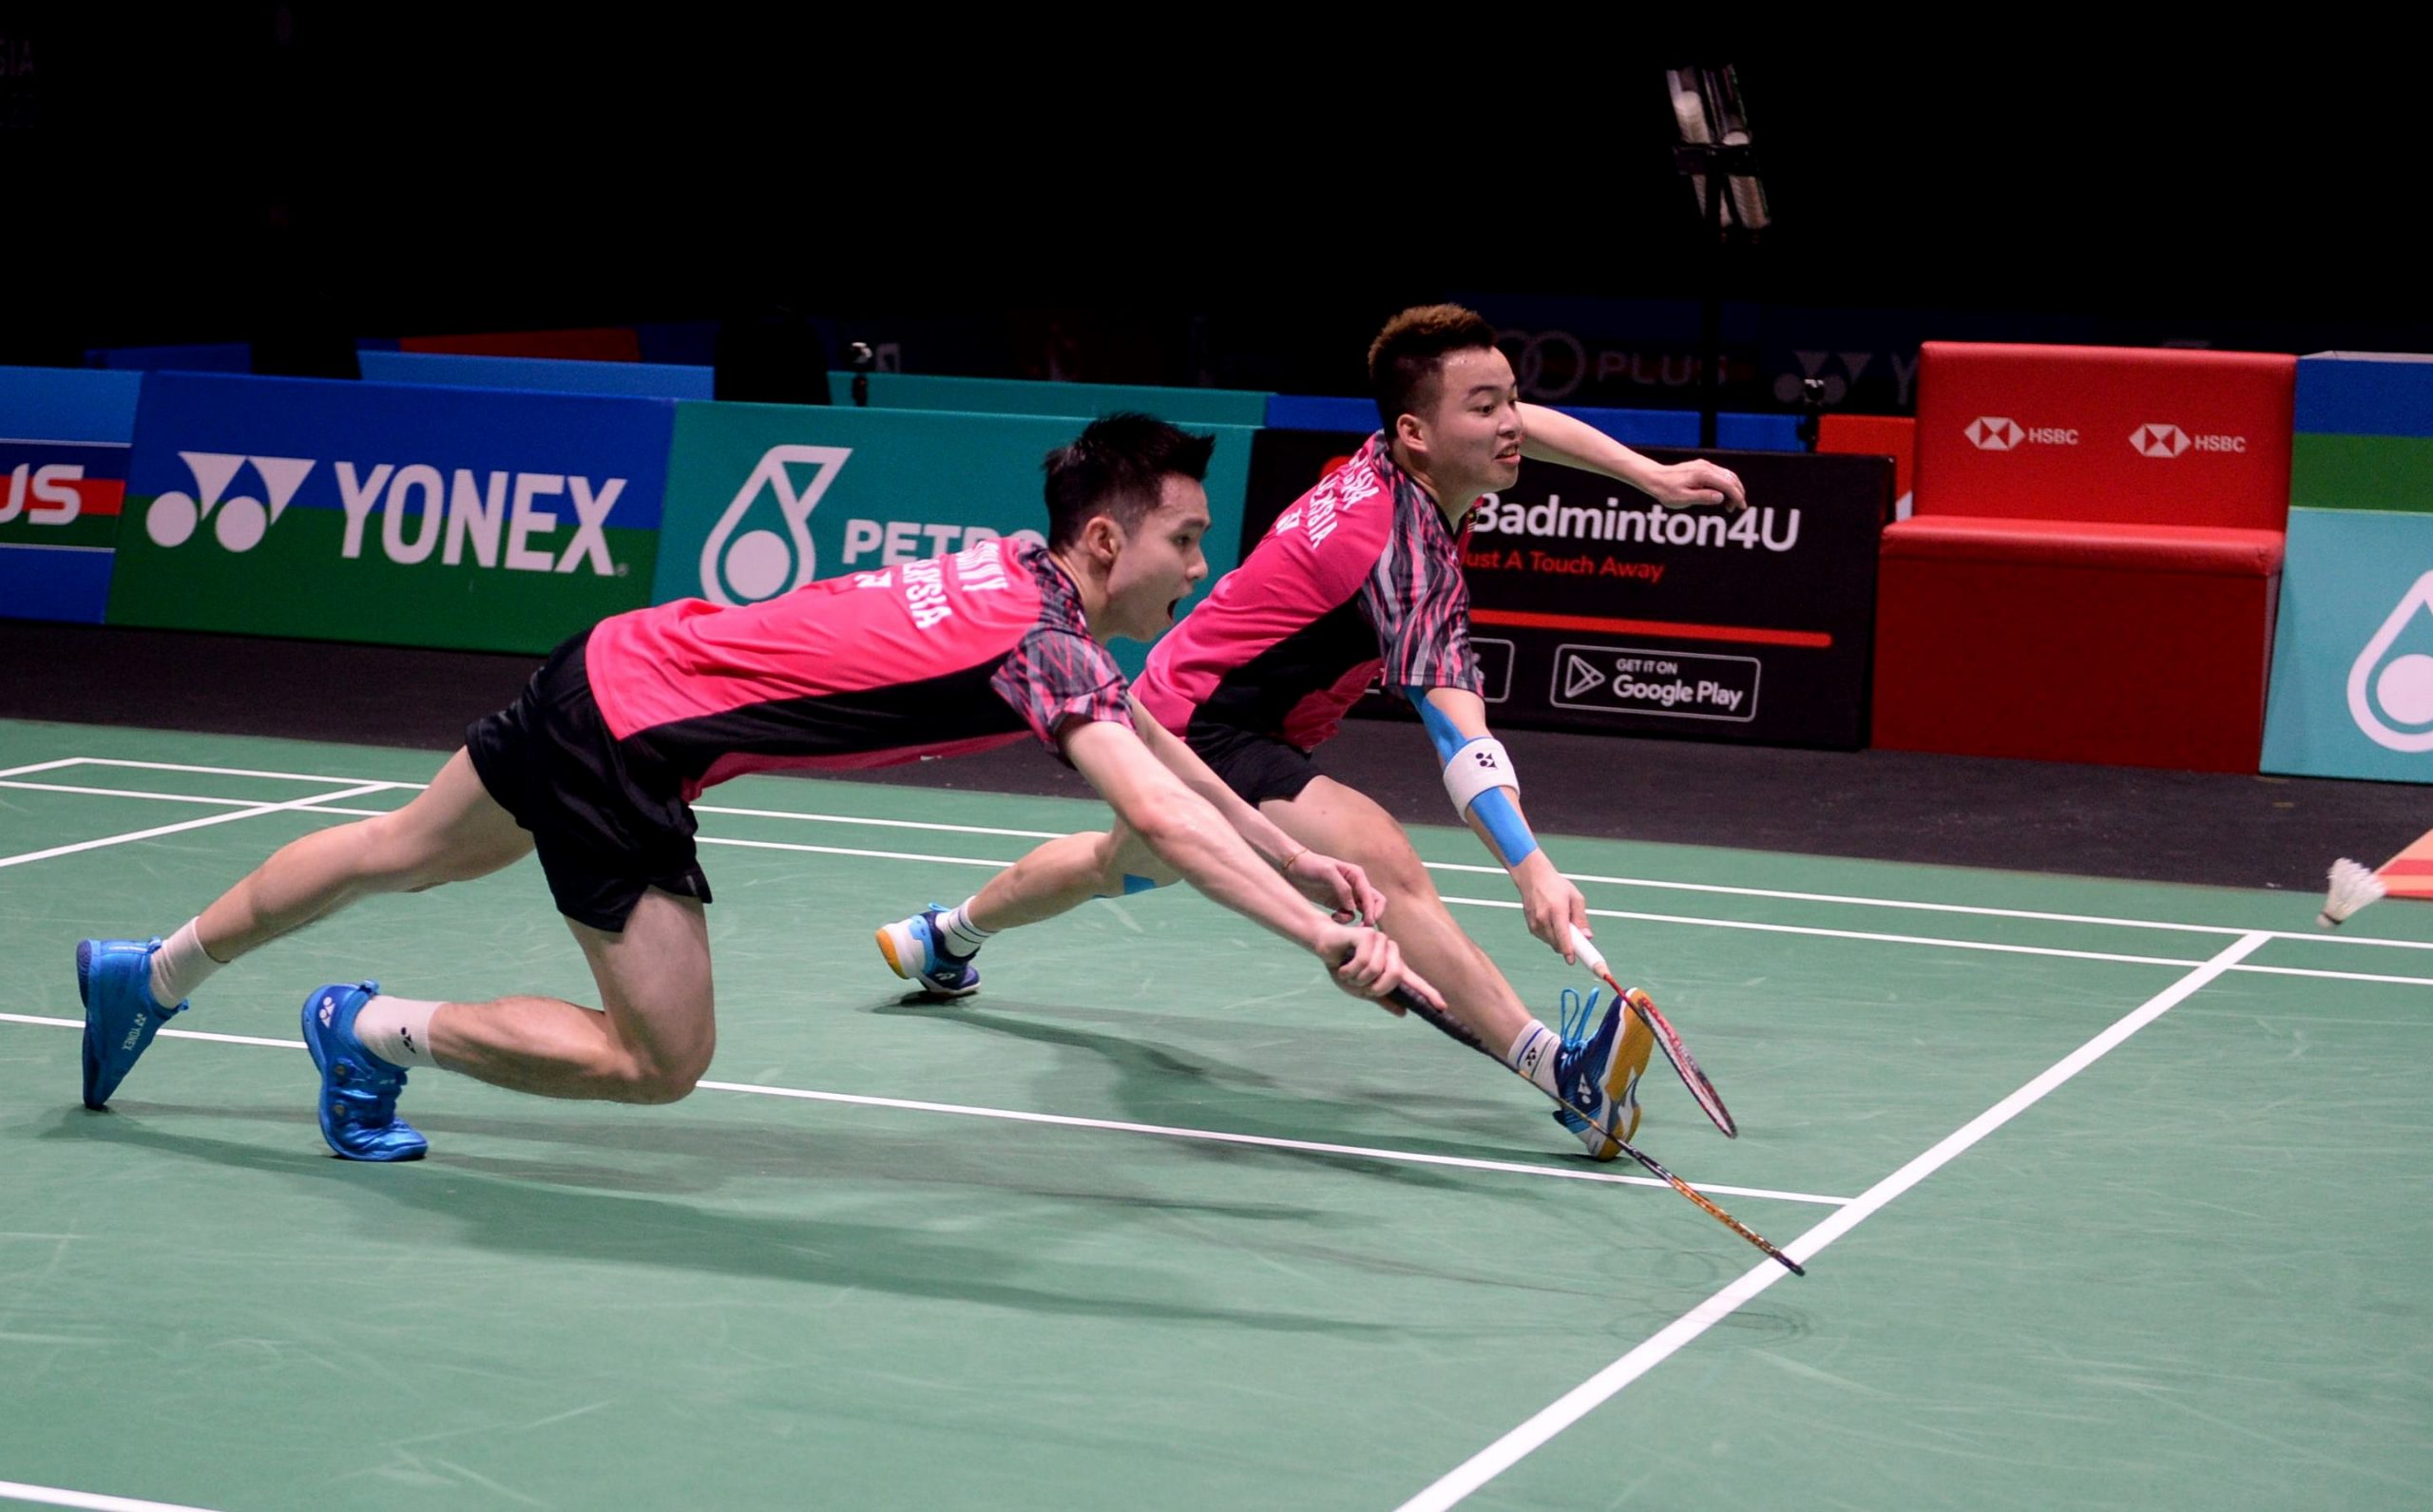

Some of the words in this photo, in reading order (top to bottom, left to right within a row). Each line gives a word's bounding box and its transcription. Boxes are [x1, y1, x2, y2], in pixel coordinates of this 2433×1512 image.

[2028, 428, 2079, 446] HSBC
[2194, 434, 2246, 453] HSBC
[333, 460, 627, 576] YONEX
[1474, 492, 1800, 552] Badminton4U
[1465, 550, 1500, 568] ust
[1504, 550, 1523, 570] A
[1530, 551, 1594, 575] Touch
[1600, 560, 1664, 583] Away
[1616, 658, 1643, 673] GET
[1644, 660, 1656, 673] IT
[1657, 660, 1677, 674] ON
[1613, 675, 1694, 707] Google
[1696, 680, 1744, 712] Play
